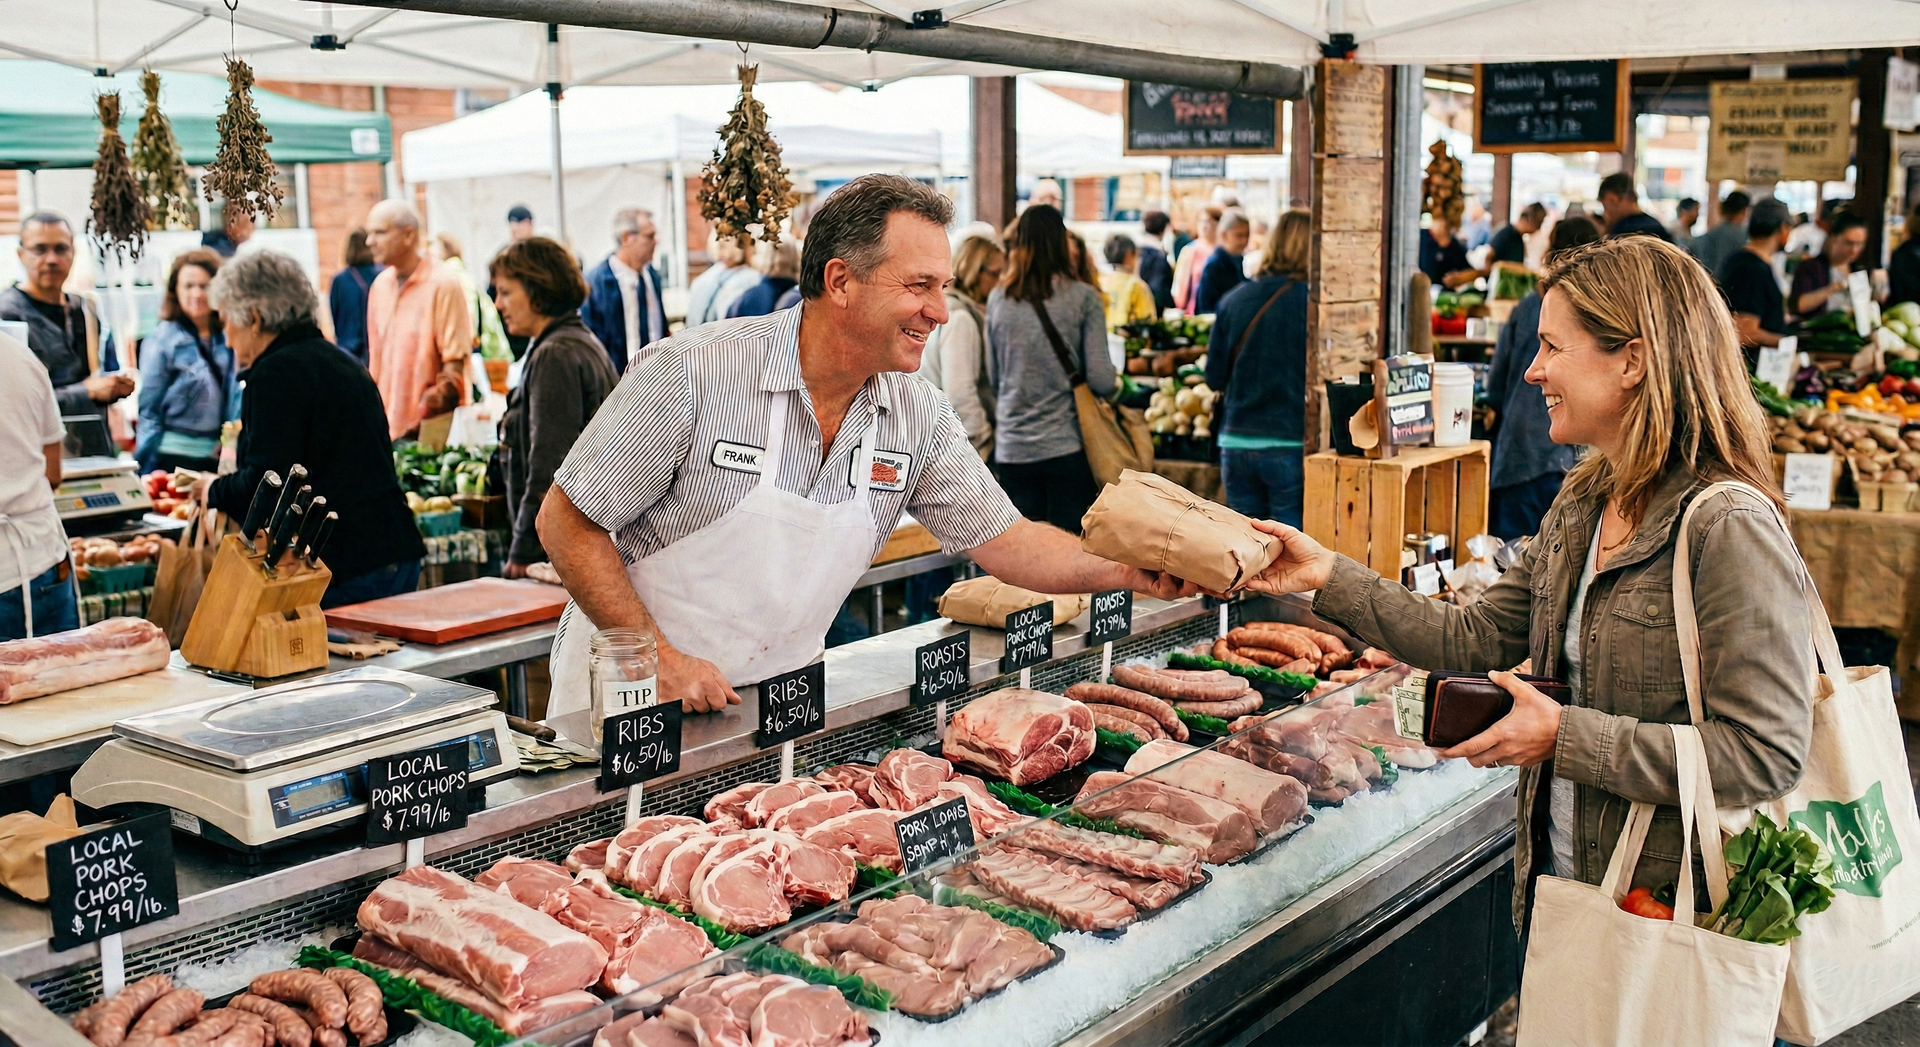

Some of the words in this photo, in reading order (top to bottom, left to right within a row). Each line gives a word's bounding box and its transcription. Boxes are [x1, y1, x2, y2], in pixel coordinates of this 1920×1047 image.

[723, 449, 757, 466] FRANK
[1095, 590, 1126, 615] ROASTS
[1014, 608, 1044, 629] LOCAL
[1006, 629, 1027, 649] PORK
[921, 641, 966, 672] ROASTS
[617, 687, 652, 707] TIP
[768, 675, 810, 706] RIBS
[618, 712, 665, 746] RIBS
[764, 698, 820, 735] $6.50/lb
[388, 752, 449, 782] LOCAL
[611, 740, 673, 776] $6.50/lb
[371, 781, 415, 810] PORK
[417, 770, 467, 799] CHOPS
[382, 797, 451, 832] $7.99/lb
[899, 815, 929, 844] PORK
[70, 829, 143, 866] LOCAL
[75, 852, 135, 888] PORK
[74, 872, 148, 911] CHOPS
